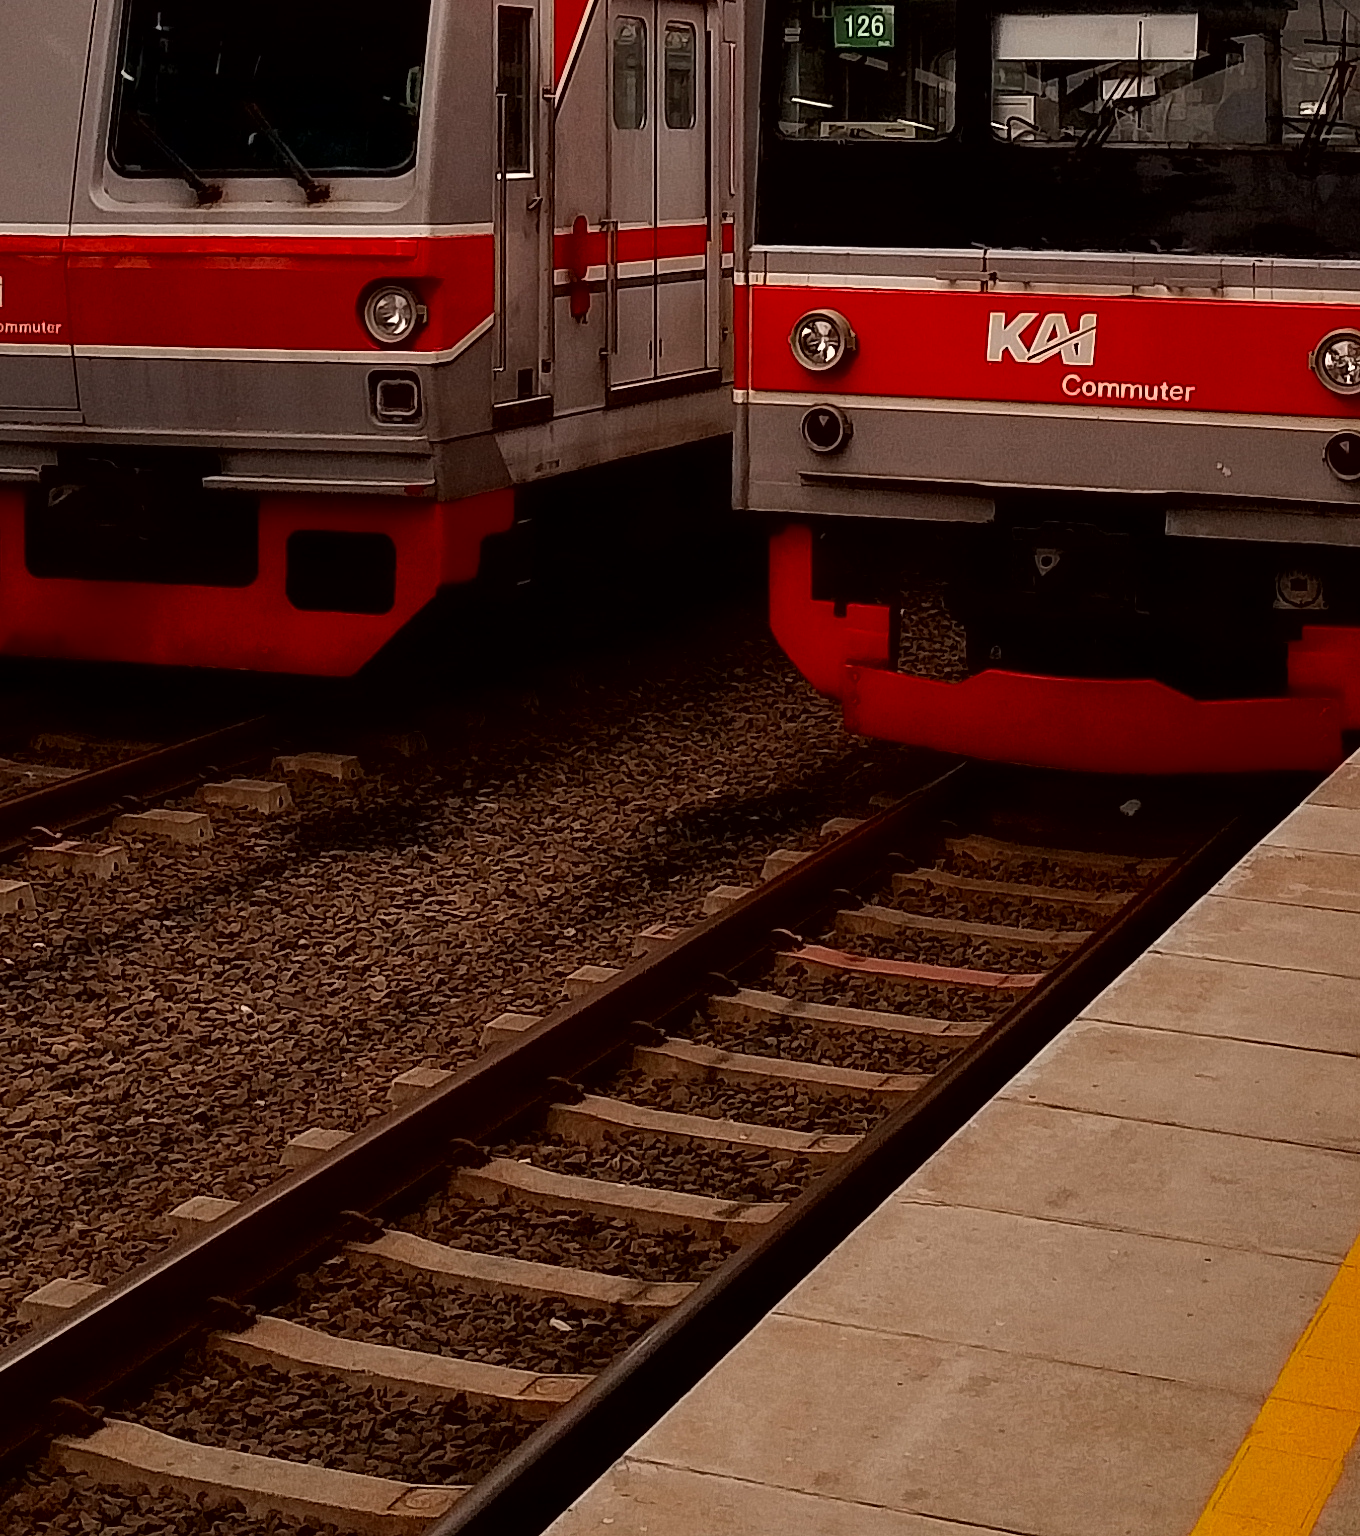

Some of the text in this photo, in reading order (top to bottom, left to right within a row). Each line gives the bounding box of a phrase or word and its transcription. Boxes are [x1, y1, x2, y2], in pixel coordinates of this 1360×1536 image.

[844, 13, 884, 38] 126
[987, 311, 1098, 366] KAI
[1061, 373, 1196, 403] Commuter
